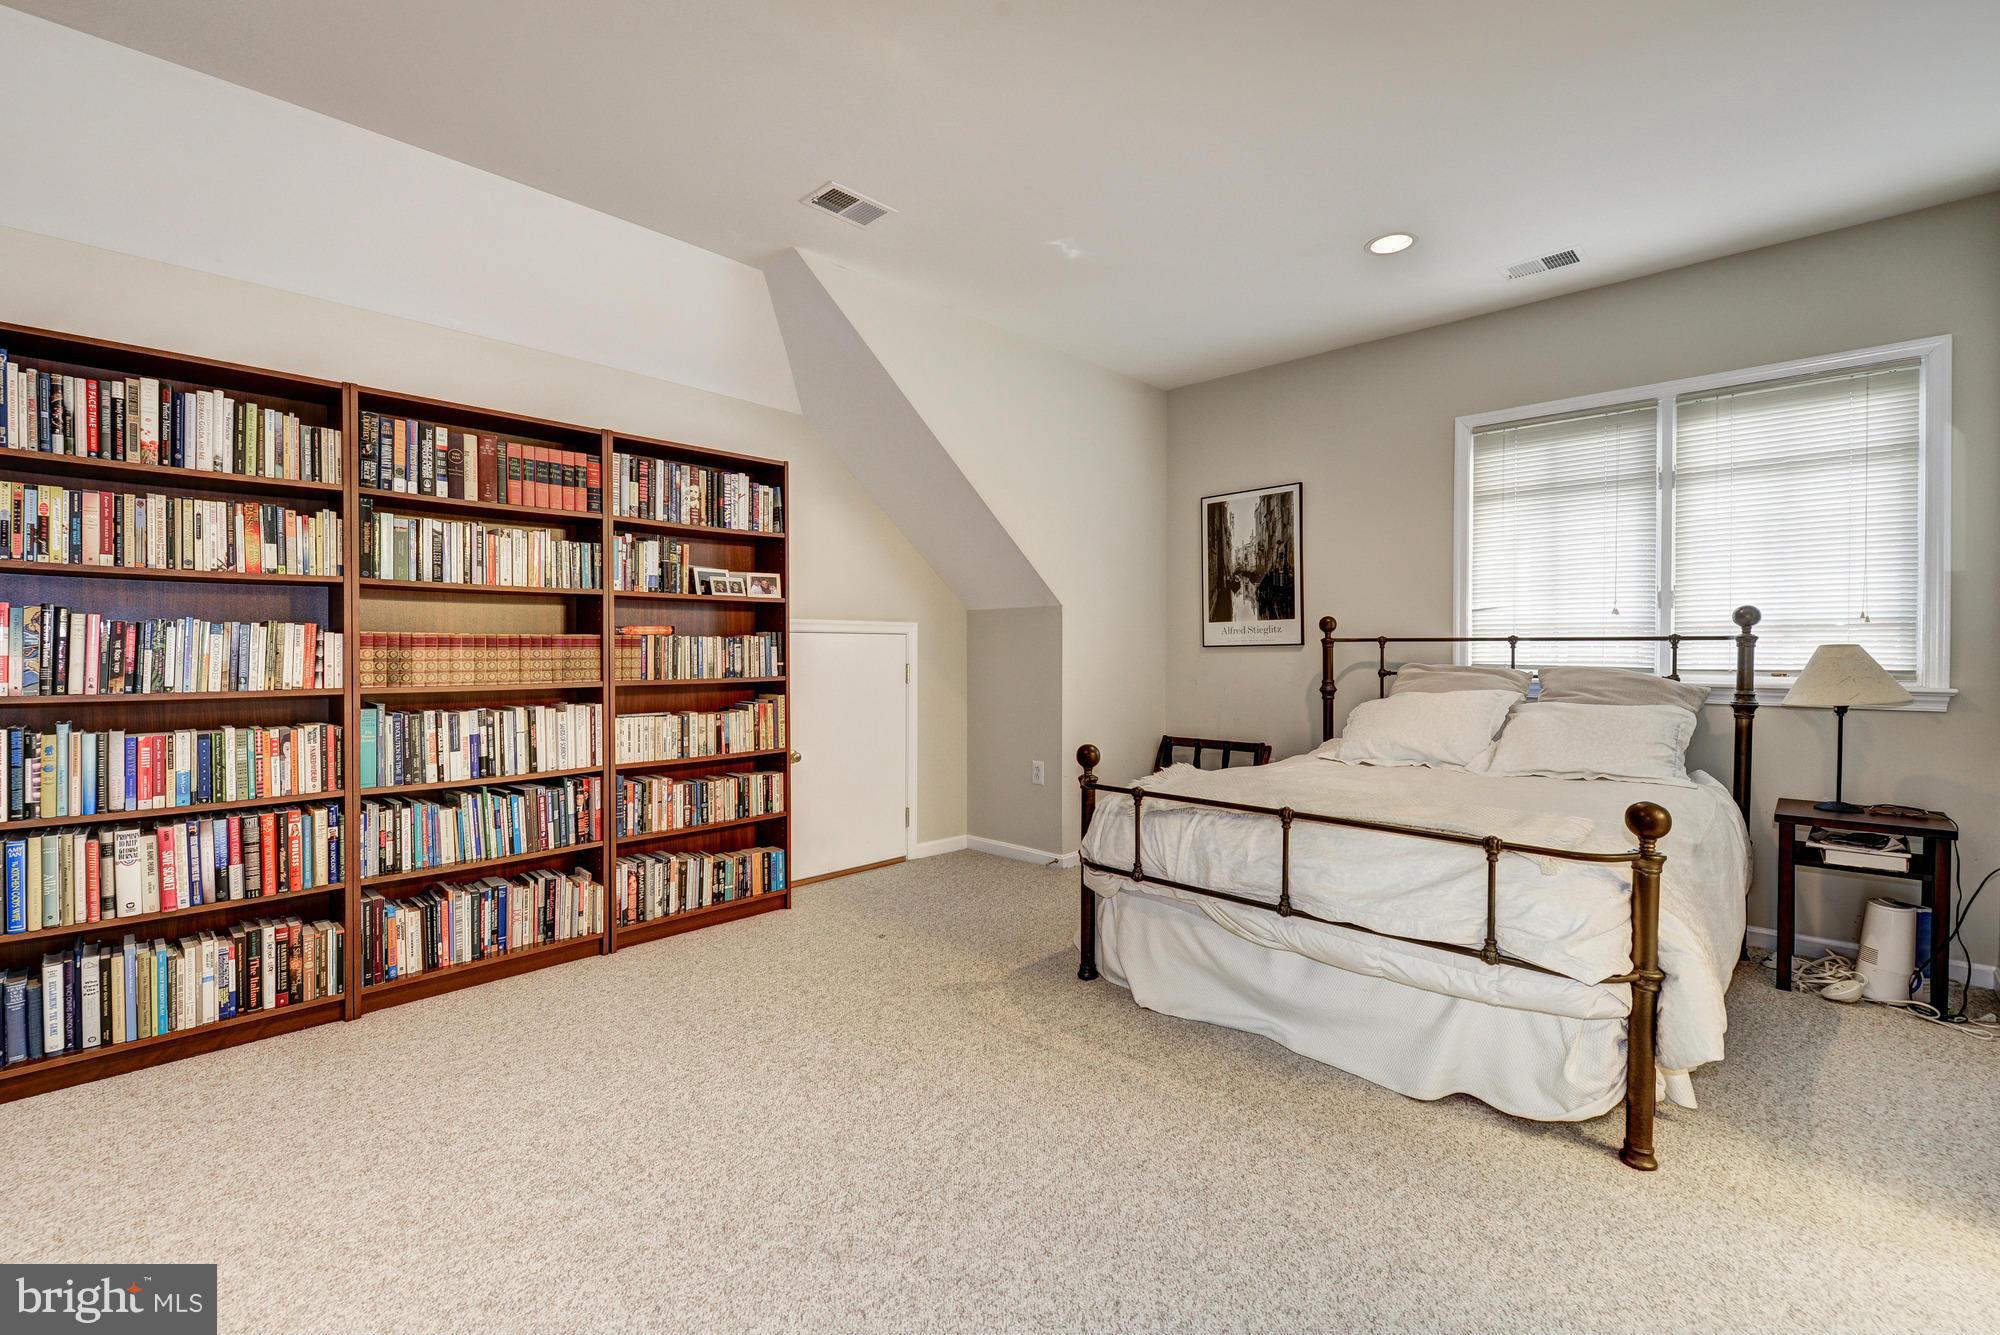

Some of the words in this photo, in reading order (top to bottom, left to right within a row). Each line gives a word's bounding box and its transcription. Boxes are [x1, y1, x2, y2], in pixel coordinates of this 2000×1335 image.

[88, 390, 97, 427] FACE-TIME
[162, 402, 170, 420] Perfect
[640, 477, 648, 502] THEROUX
[1221, 624, 1246, 635] Alfred
[1248, 623, 1282, 635] Stieglitz
[128, 741, 136, 776] MIDWIVES
[12, 867, 20, 891] KITCHEN
[43, 874, 56, 895] Allah
[250, 958, 258, 976] The
[250, 976, 259, 1007] Italians
